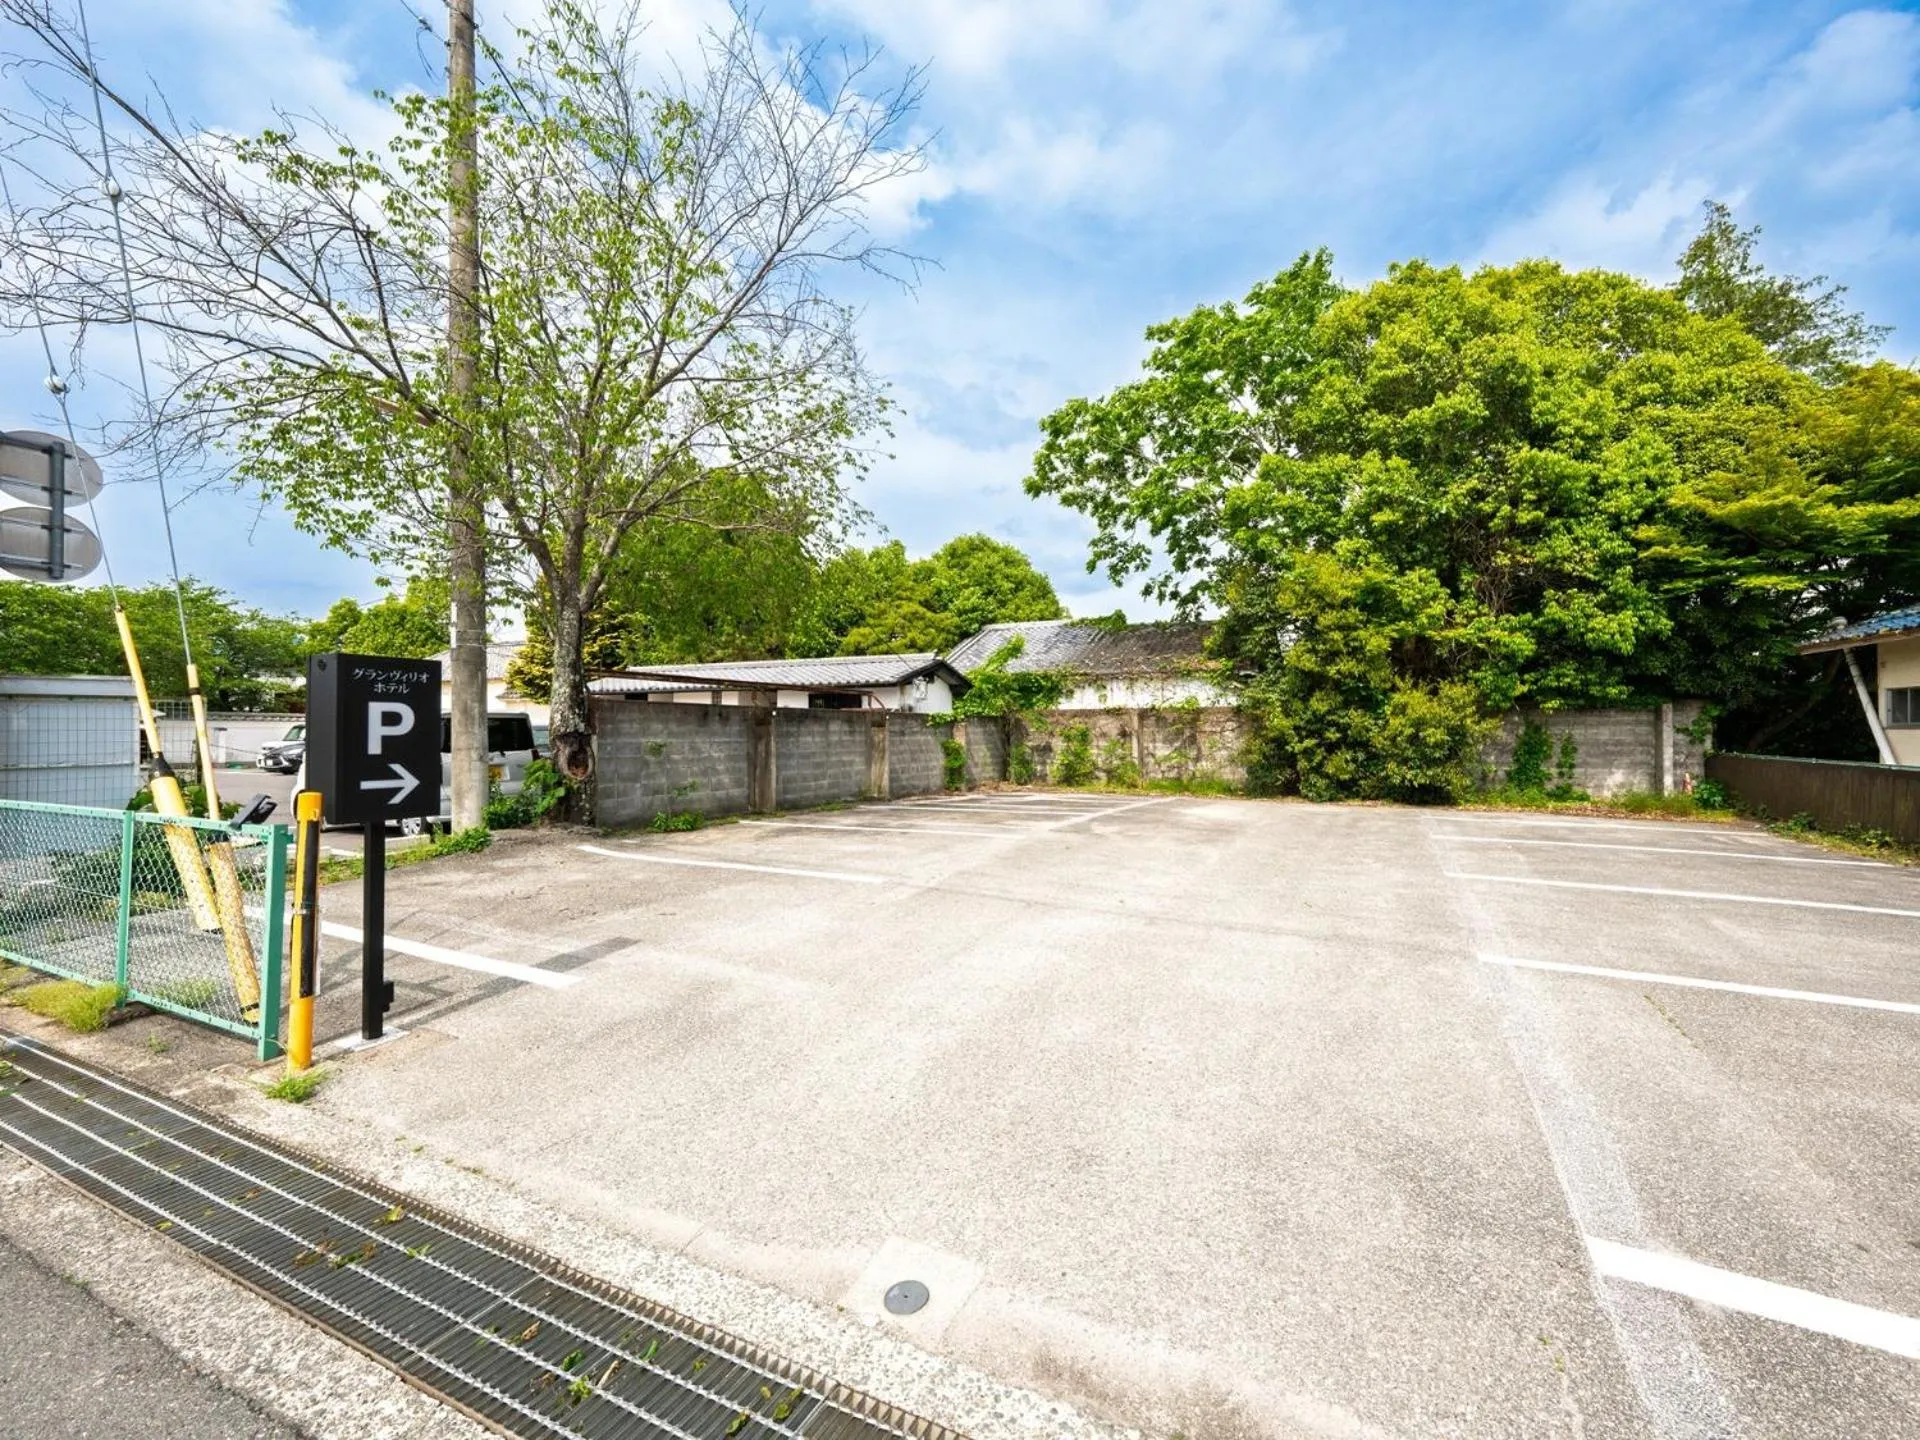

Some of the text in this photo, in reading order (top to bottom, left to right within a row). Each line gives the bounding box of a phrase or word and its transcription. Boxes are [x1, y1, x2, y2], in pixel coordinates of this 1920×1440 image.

[352, 668, 430, 683] グランヴィリオ
[373, 682, 409, 694] ホテル
[367, 701, 416, 755] P
